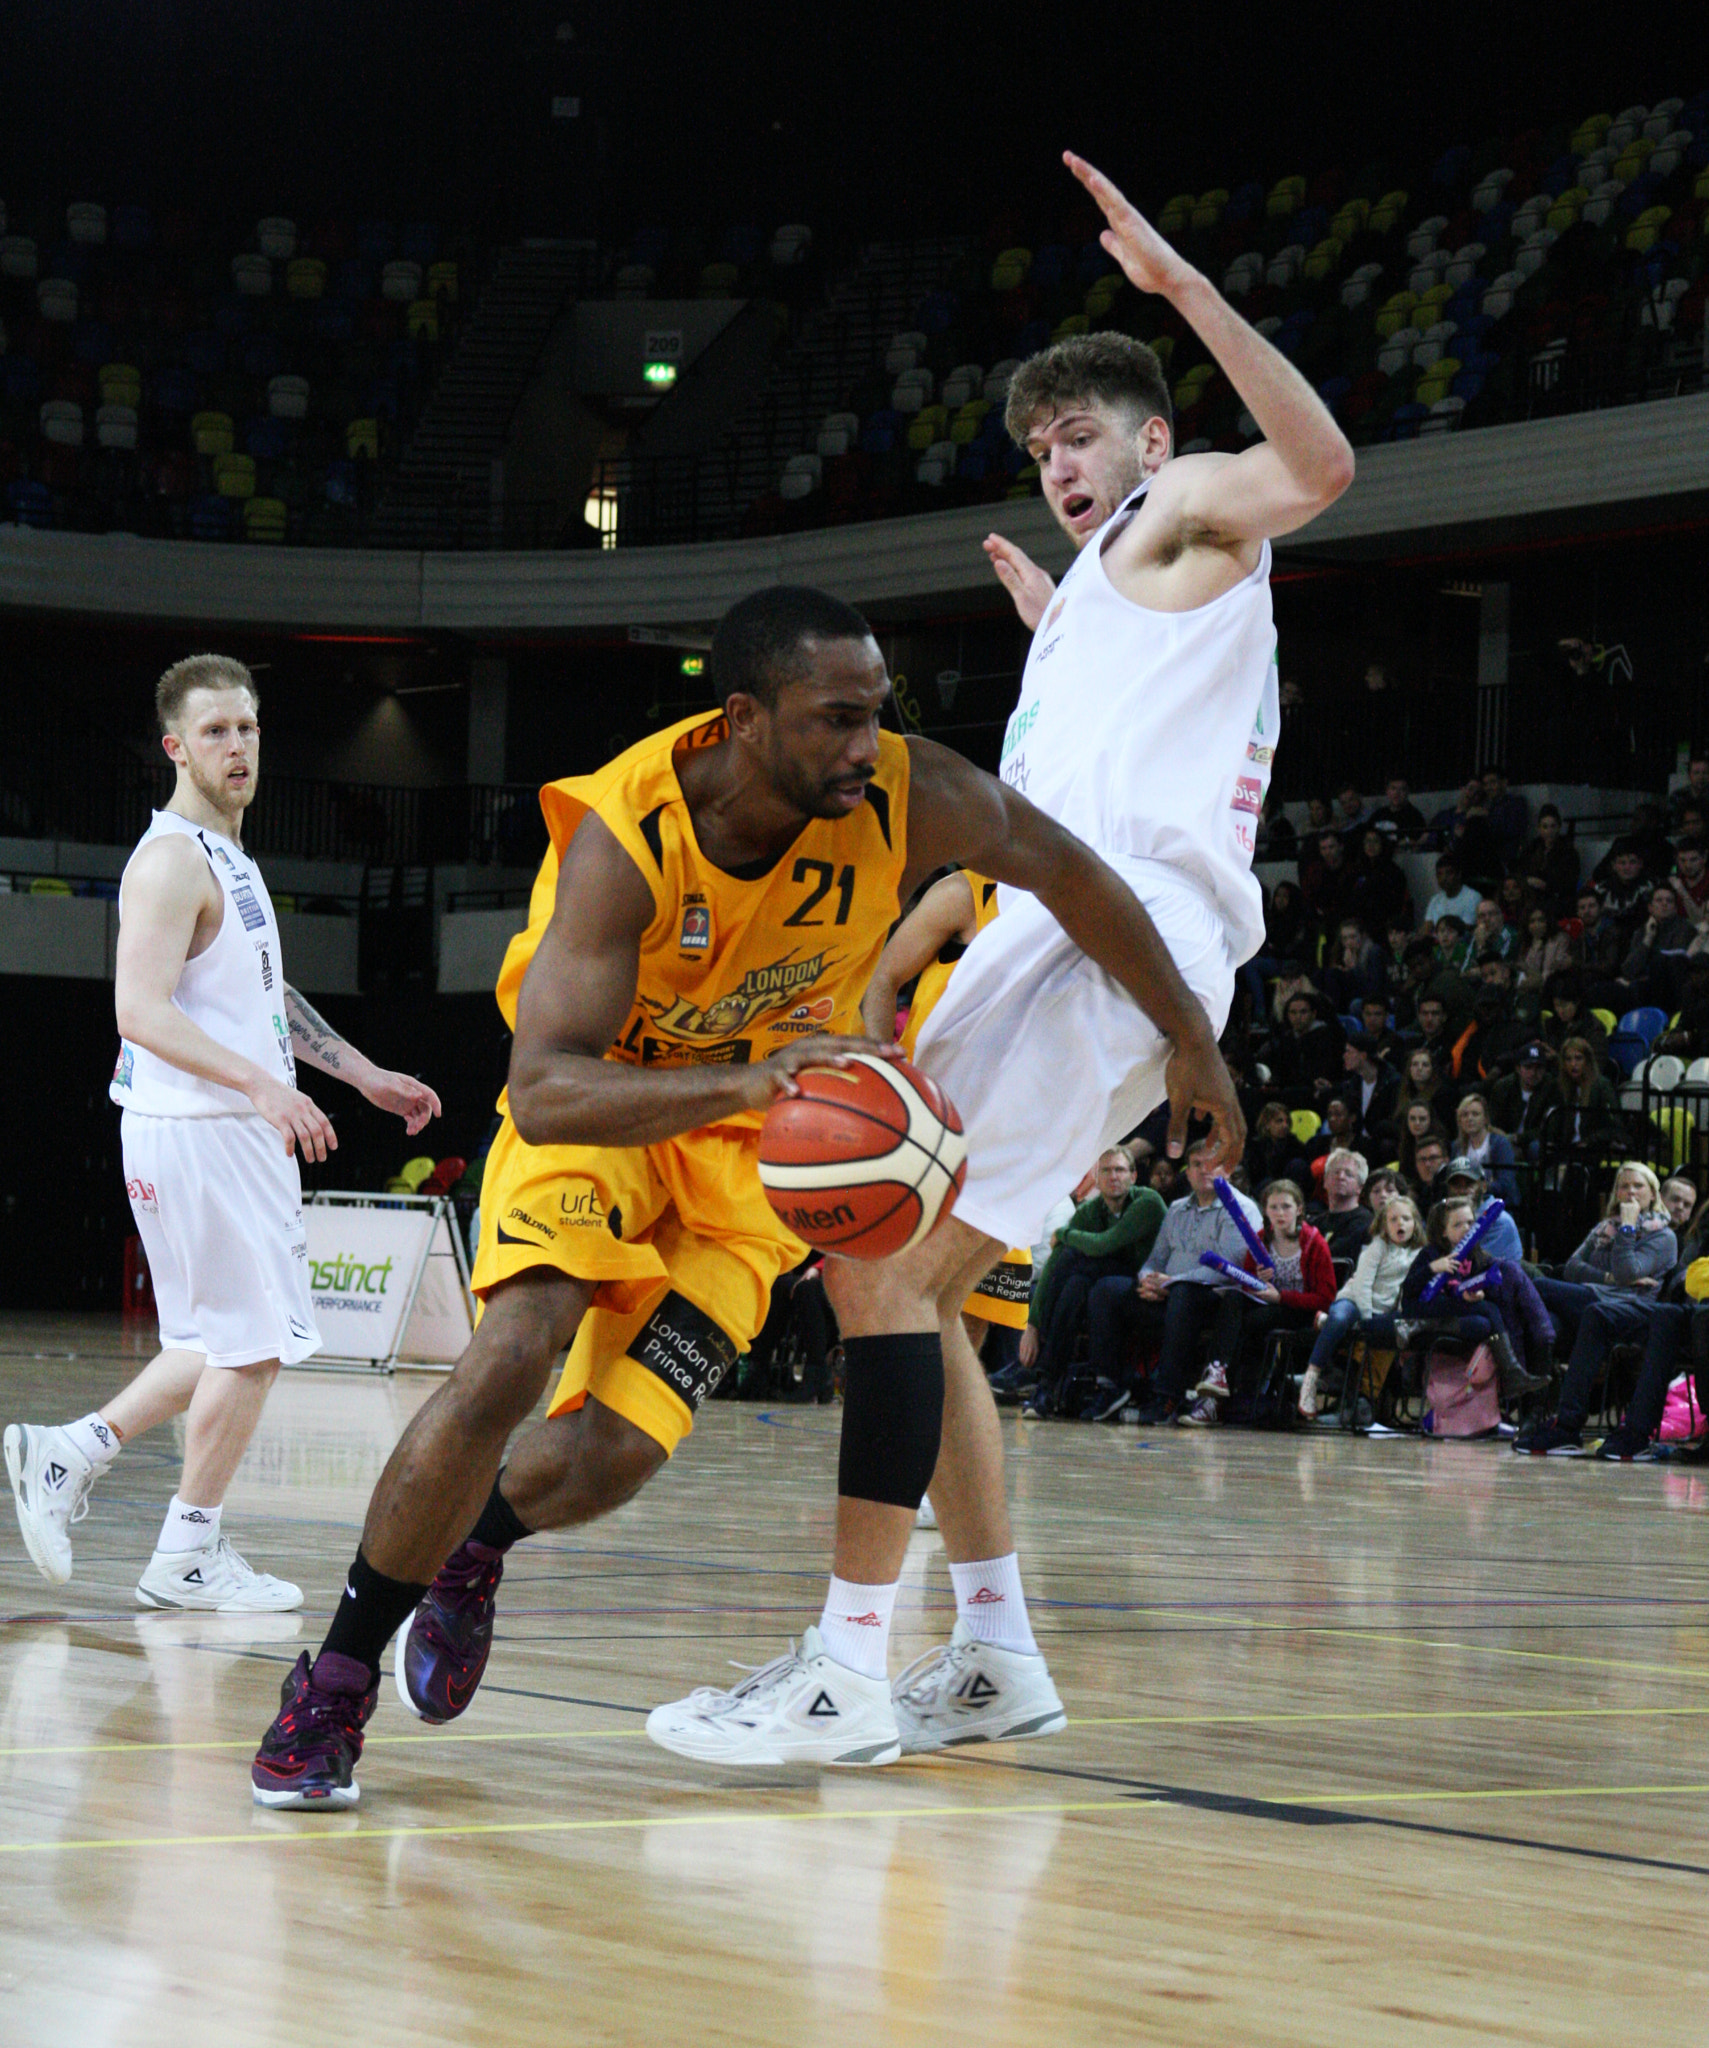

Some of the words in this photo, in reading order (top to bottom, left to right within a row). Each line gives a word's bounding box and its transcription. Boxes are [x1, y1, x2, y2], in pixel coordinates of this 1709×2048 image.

[649, 336, 680, 353] 209
[782, 857, 856, 927] 21
[746, 957, 822, 994] LONDON
[507, 1207, 558, 1241] SPALDING
[558, 1215, 602, 1228] student
[308, 1252, 393, 1295] nstinct
[315, 1297, 382, 1313] PERFORMANCE
[649, 1313, 709, 1372] London
[643, 1338, 693, 1389] Prince
[180, 1513, 213, 1525] PEAK
[966, 1591, 1006, 1605] PEAK
[846, 1615, 883, 1628] PEAK
